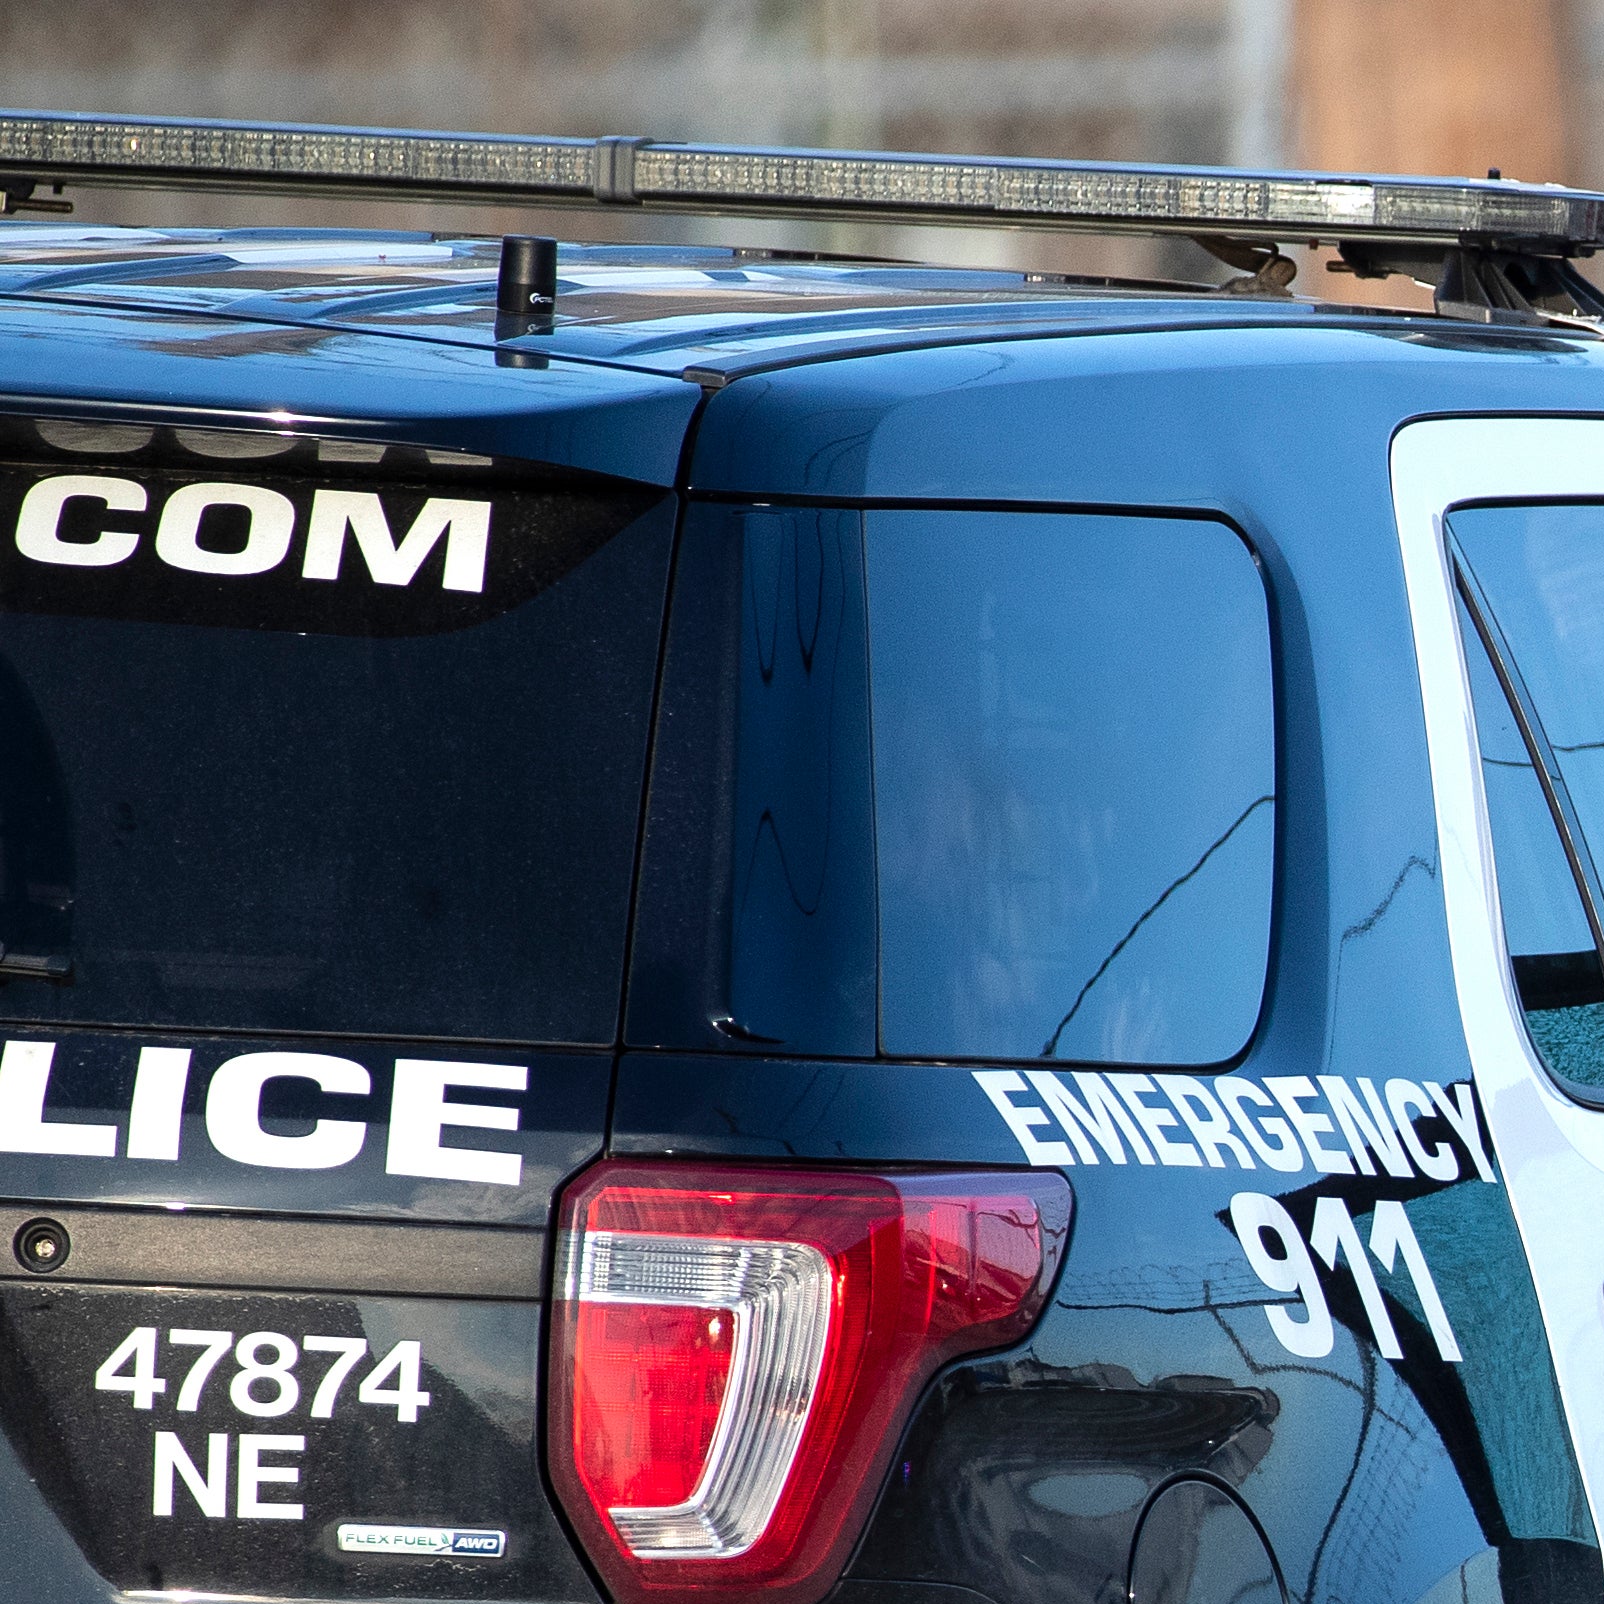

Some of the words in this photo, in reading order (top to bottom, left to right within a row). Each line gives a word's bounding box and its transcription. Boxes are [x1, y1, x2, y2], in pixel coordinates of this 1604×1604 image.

[15, 475, 491, 592] COM
[0, 1039, 529, 1186] LICE
[971, 1070, 1498, 1184] EMERGENCY
[1229, 1191, 1463, 1363] 911
[95, 1326, 430, 1423] 47874
[152, 1431, 305, 1520] NE
[345, 1534, 390, 1545] FLEX
[393, 1535, 438, 1547] FUEL
[454, 1536, 498, 1550] AWD
